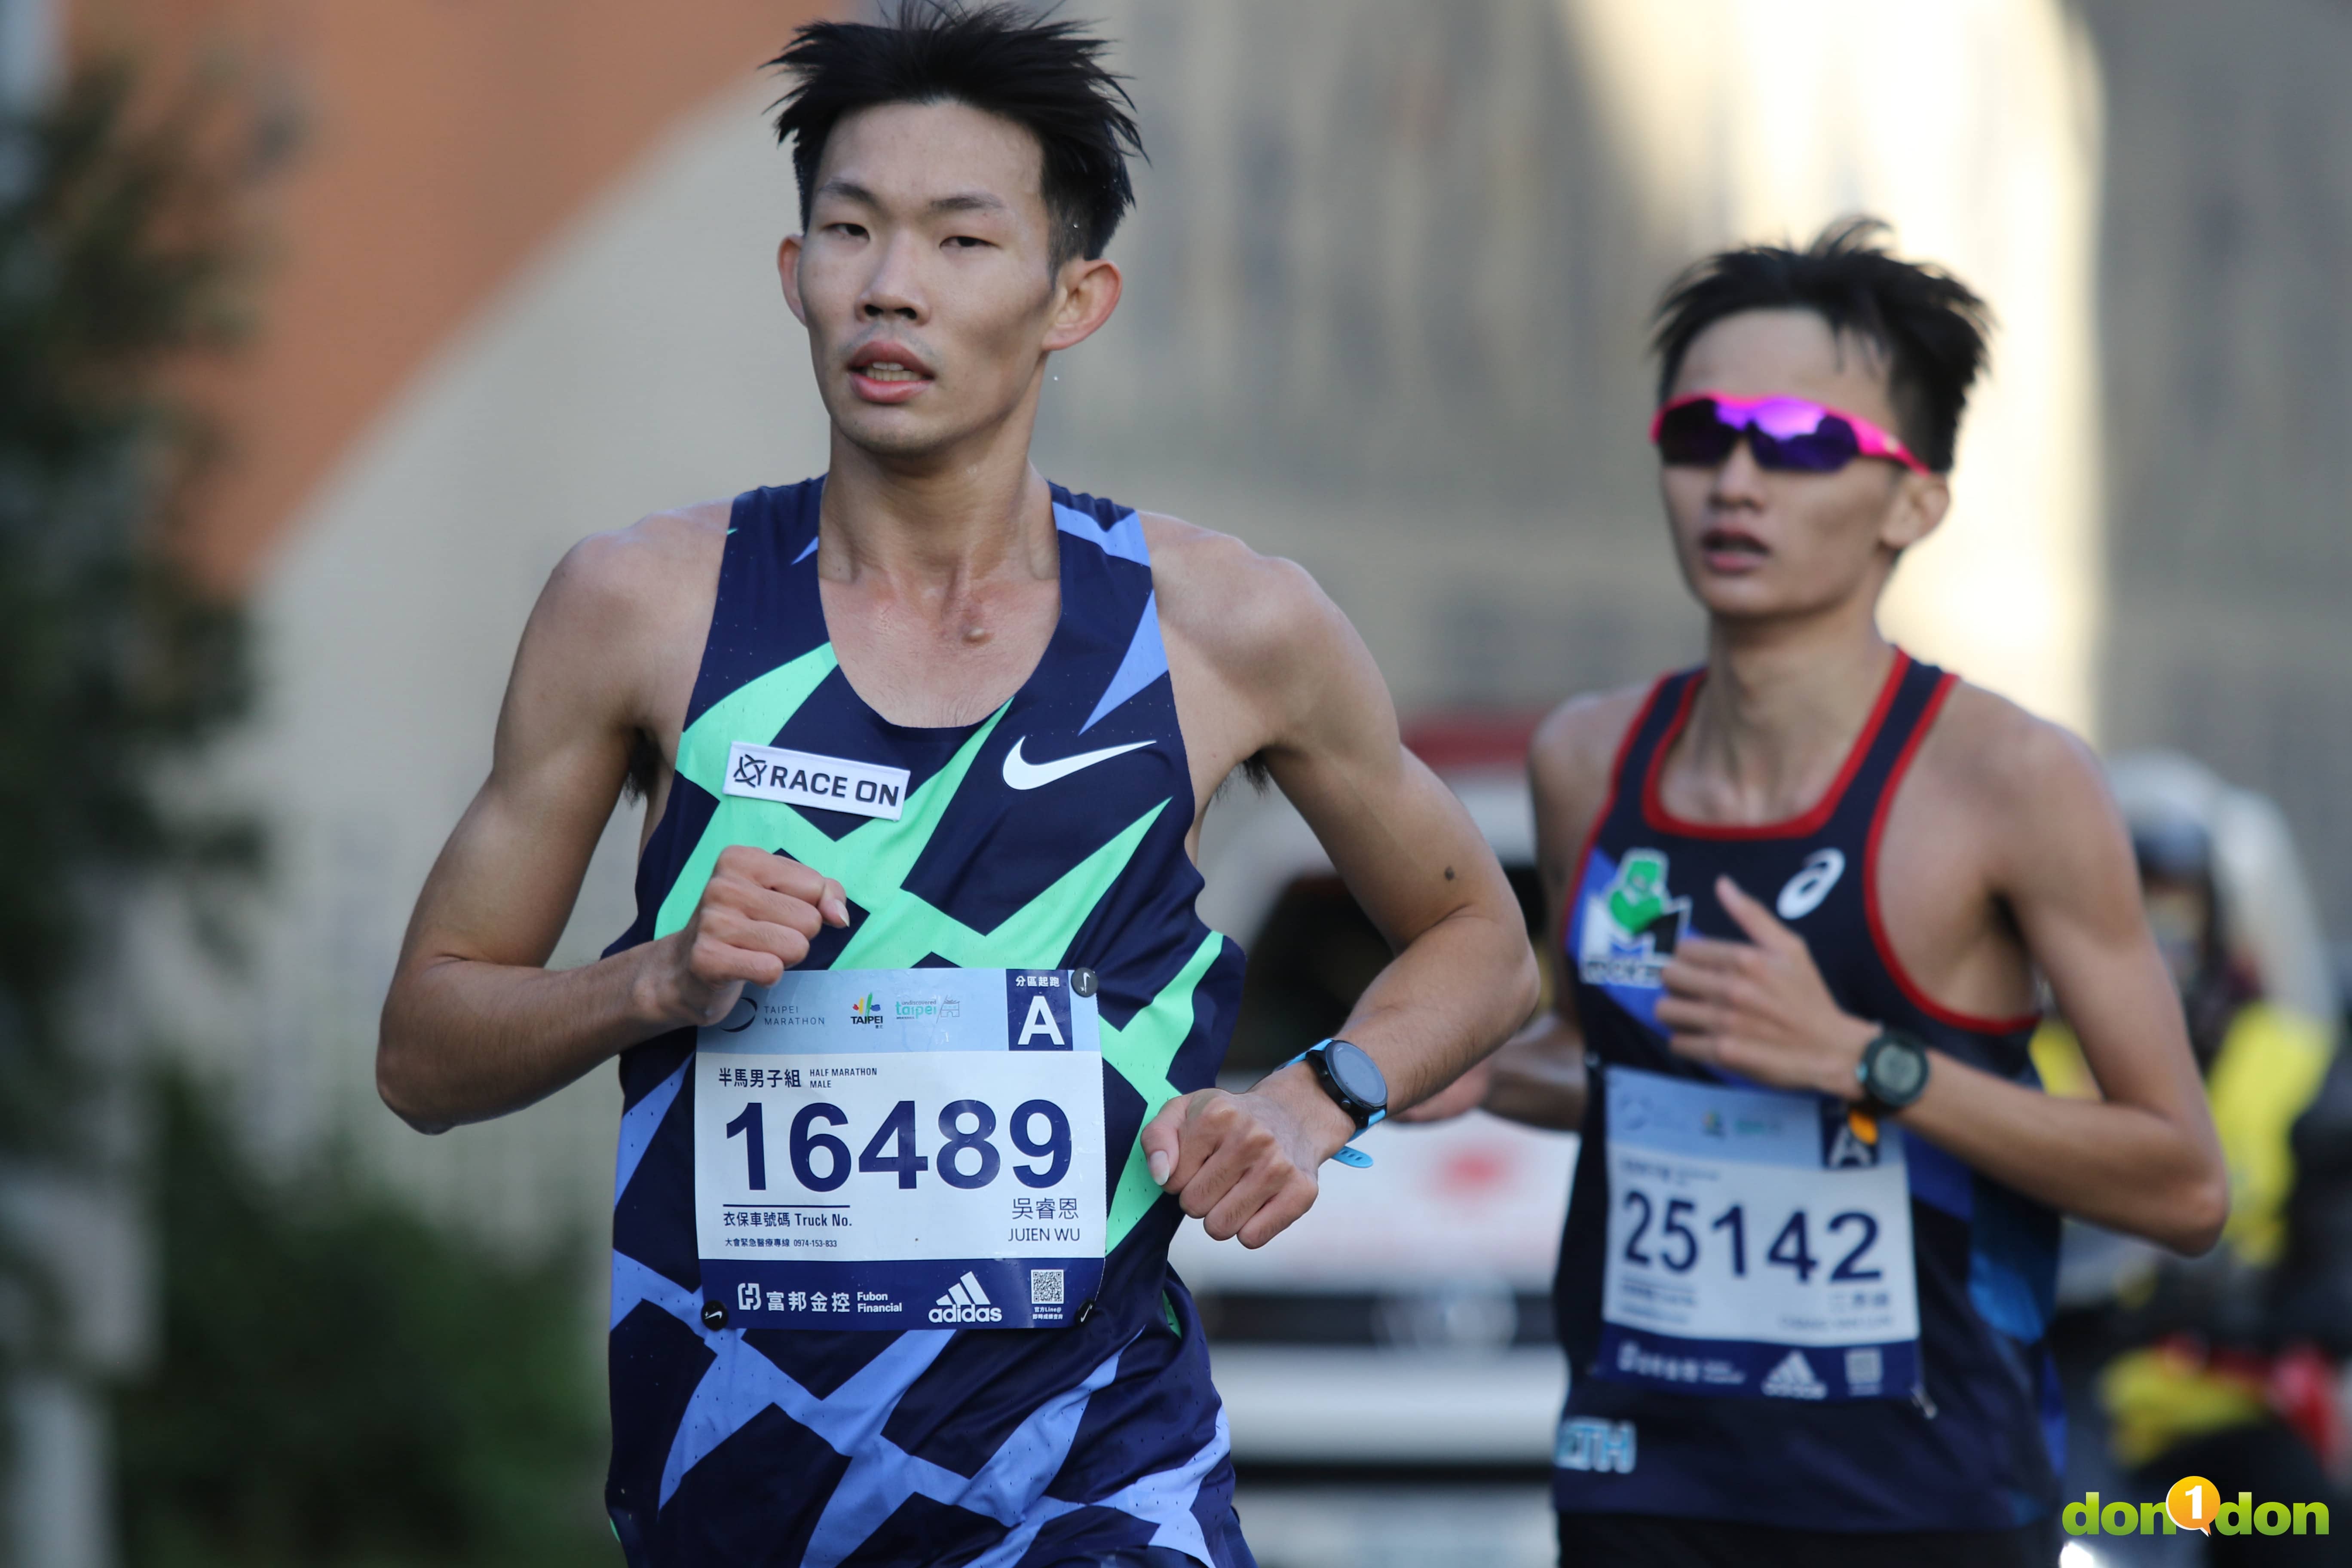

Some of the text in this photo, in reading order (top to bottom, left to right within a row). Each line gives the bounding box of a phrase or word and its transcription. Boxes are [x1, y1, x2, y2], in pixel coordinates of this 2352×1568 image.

[770, 766, 899, 807] RACE ON
[1015, 976, 1060, 987] 分區起跑
[764, 1006, 799, 1014] TAIPEI
[895, 1001, 937, 1019] taipei
[764, 1017, 825, 1025] MARATHON
[851, 1016, 883, 1024] TAIPEI
[1017, 995, 1065, 1045] A
[719, 1068, 802, 1088] 半馬男子組
[810, 1068, 877, 1077] HALF MARATHON
[810, 1080, 831, 1088] MALE
[726, 1099, 1072, 1192] 16489
[1012, 1197, 1079, 1219] 吳睿恩
[723, 1211, 852, 1227] 衣保車號碼 Truck No.
[1008, 1228, 1080, 1241] JUIEN WU
[1623, 1190, 1883, 1284] 25142
[793, 1239, 837, 1247] 0974-153-833
[766, 1291, 850, 1313] 富邦金控
[857, 1292, 888, 1301] Fubon
[857, 1303, 902, 1313] Financial
[928, 1304, 1002, 1323] adidas
